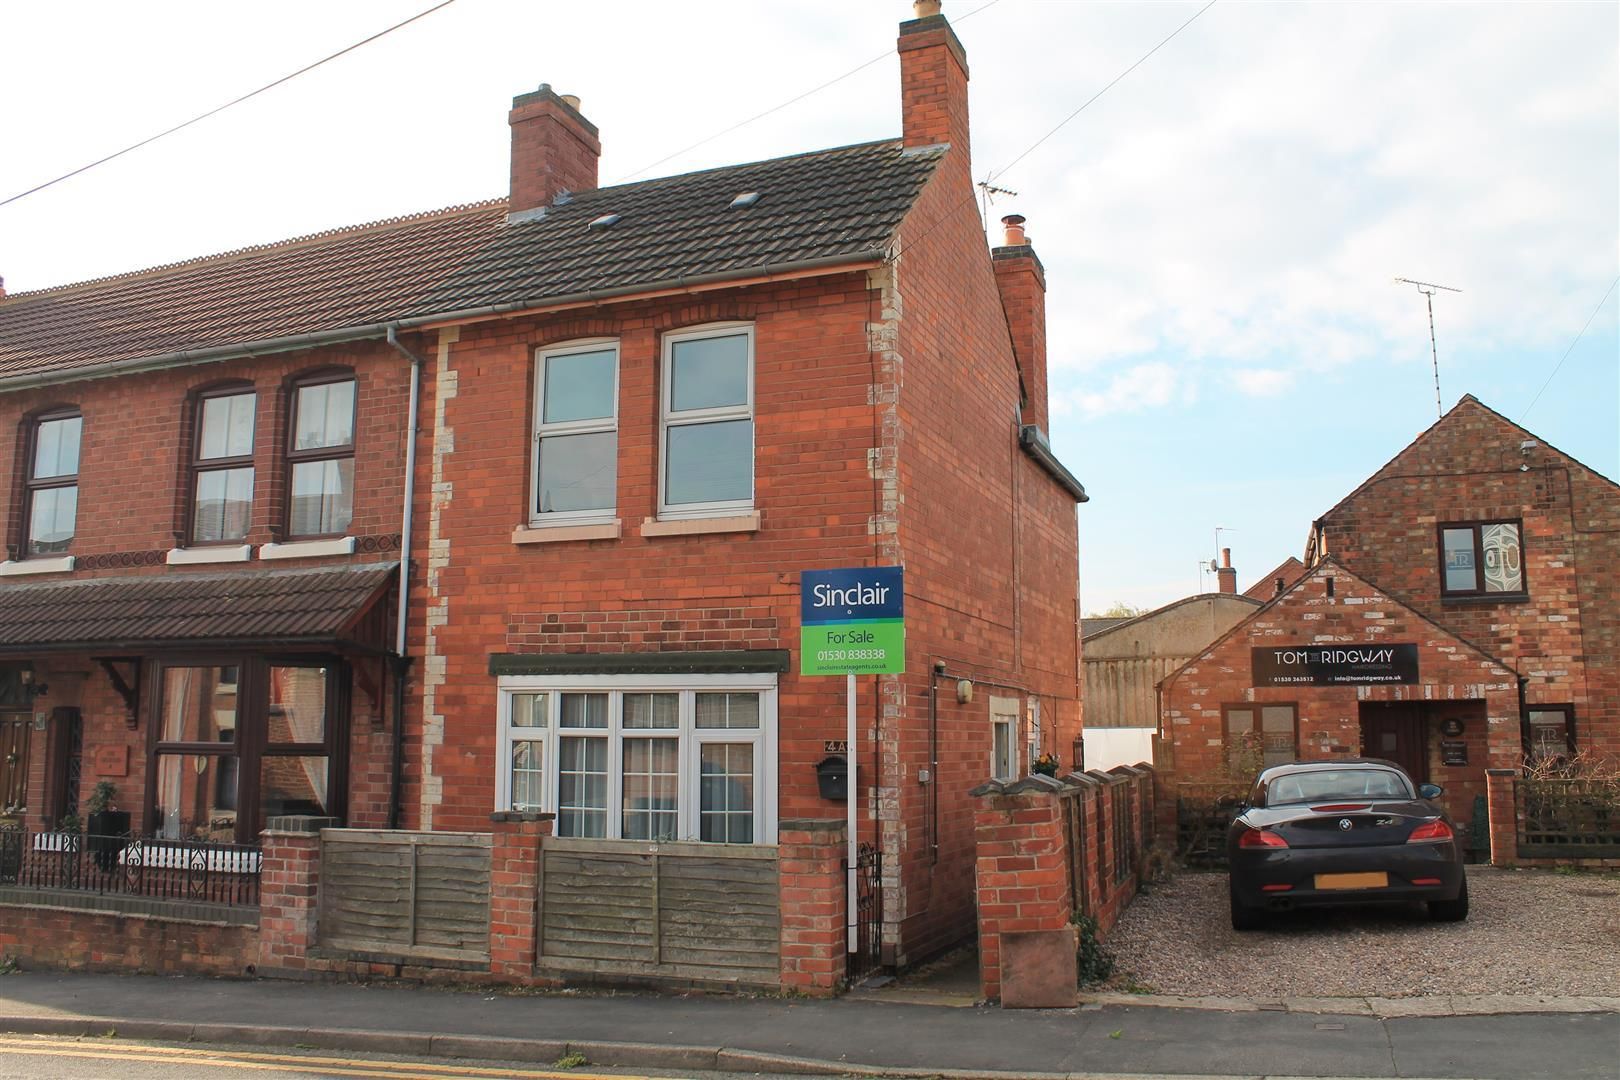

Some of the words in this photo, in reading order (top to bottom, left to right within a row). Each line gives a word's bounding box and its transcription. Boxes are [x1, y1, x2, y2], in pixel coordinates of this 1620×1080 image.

[813, 581, 890, 607] Sinclair
[827, 631, 846, 644] For
[848, 630, 874, 644] Sale
[817, 650, 846, 661] 01530
[848, 648, 886, 660] 838338
[1274, 651, 1308, 665] TOM
[1321, 649, 1394, 664] RIDGWAY
[827, 740, 846, 752] 4A
[1375, 817, 1394, 826] Z4
